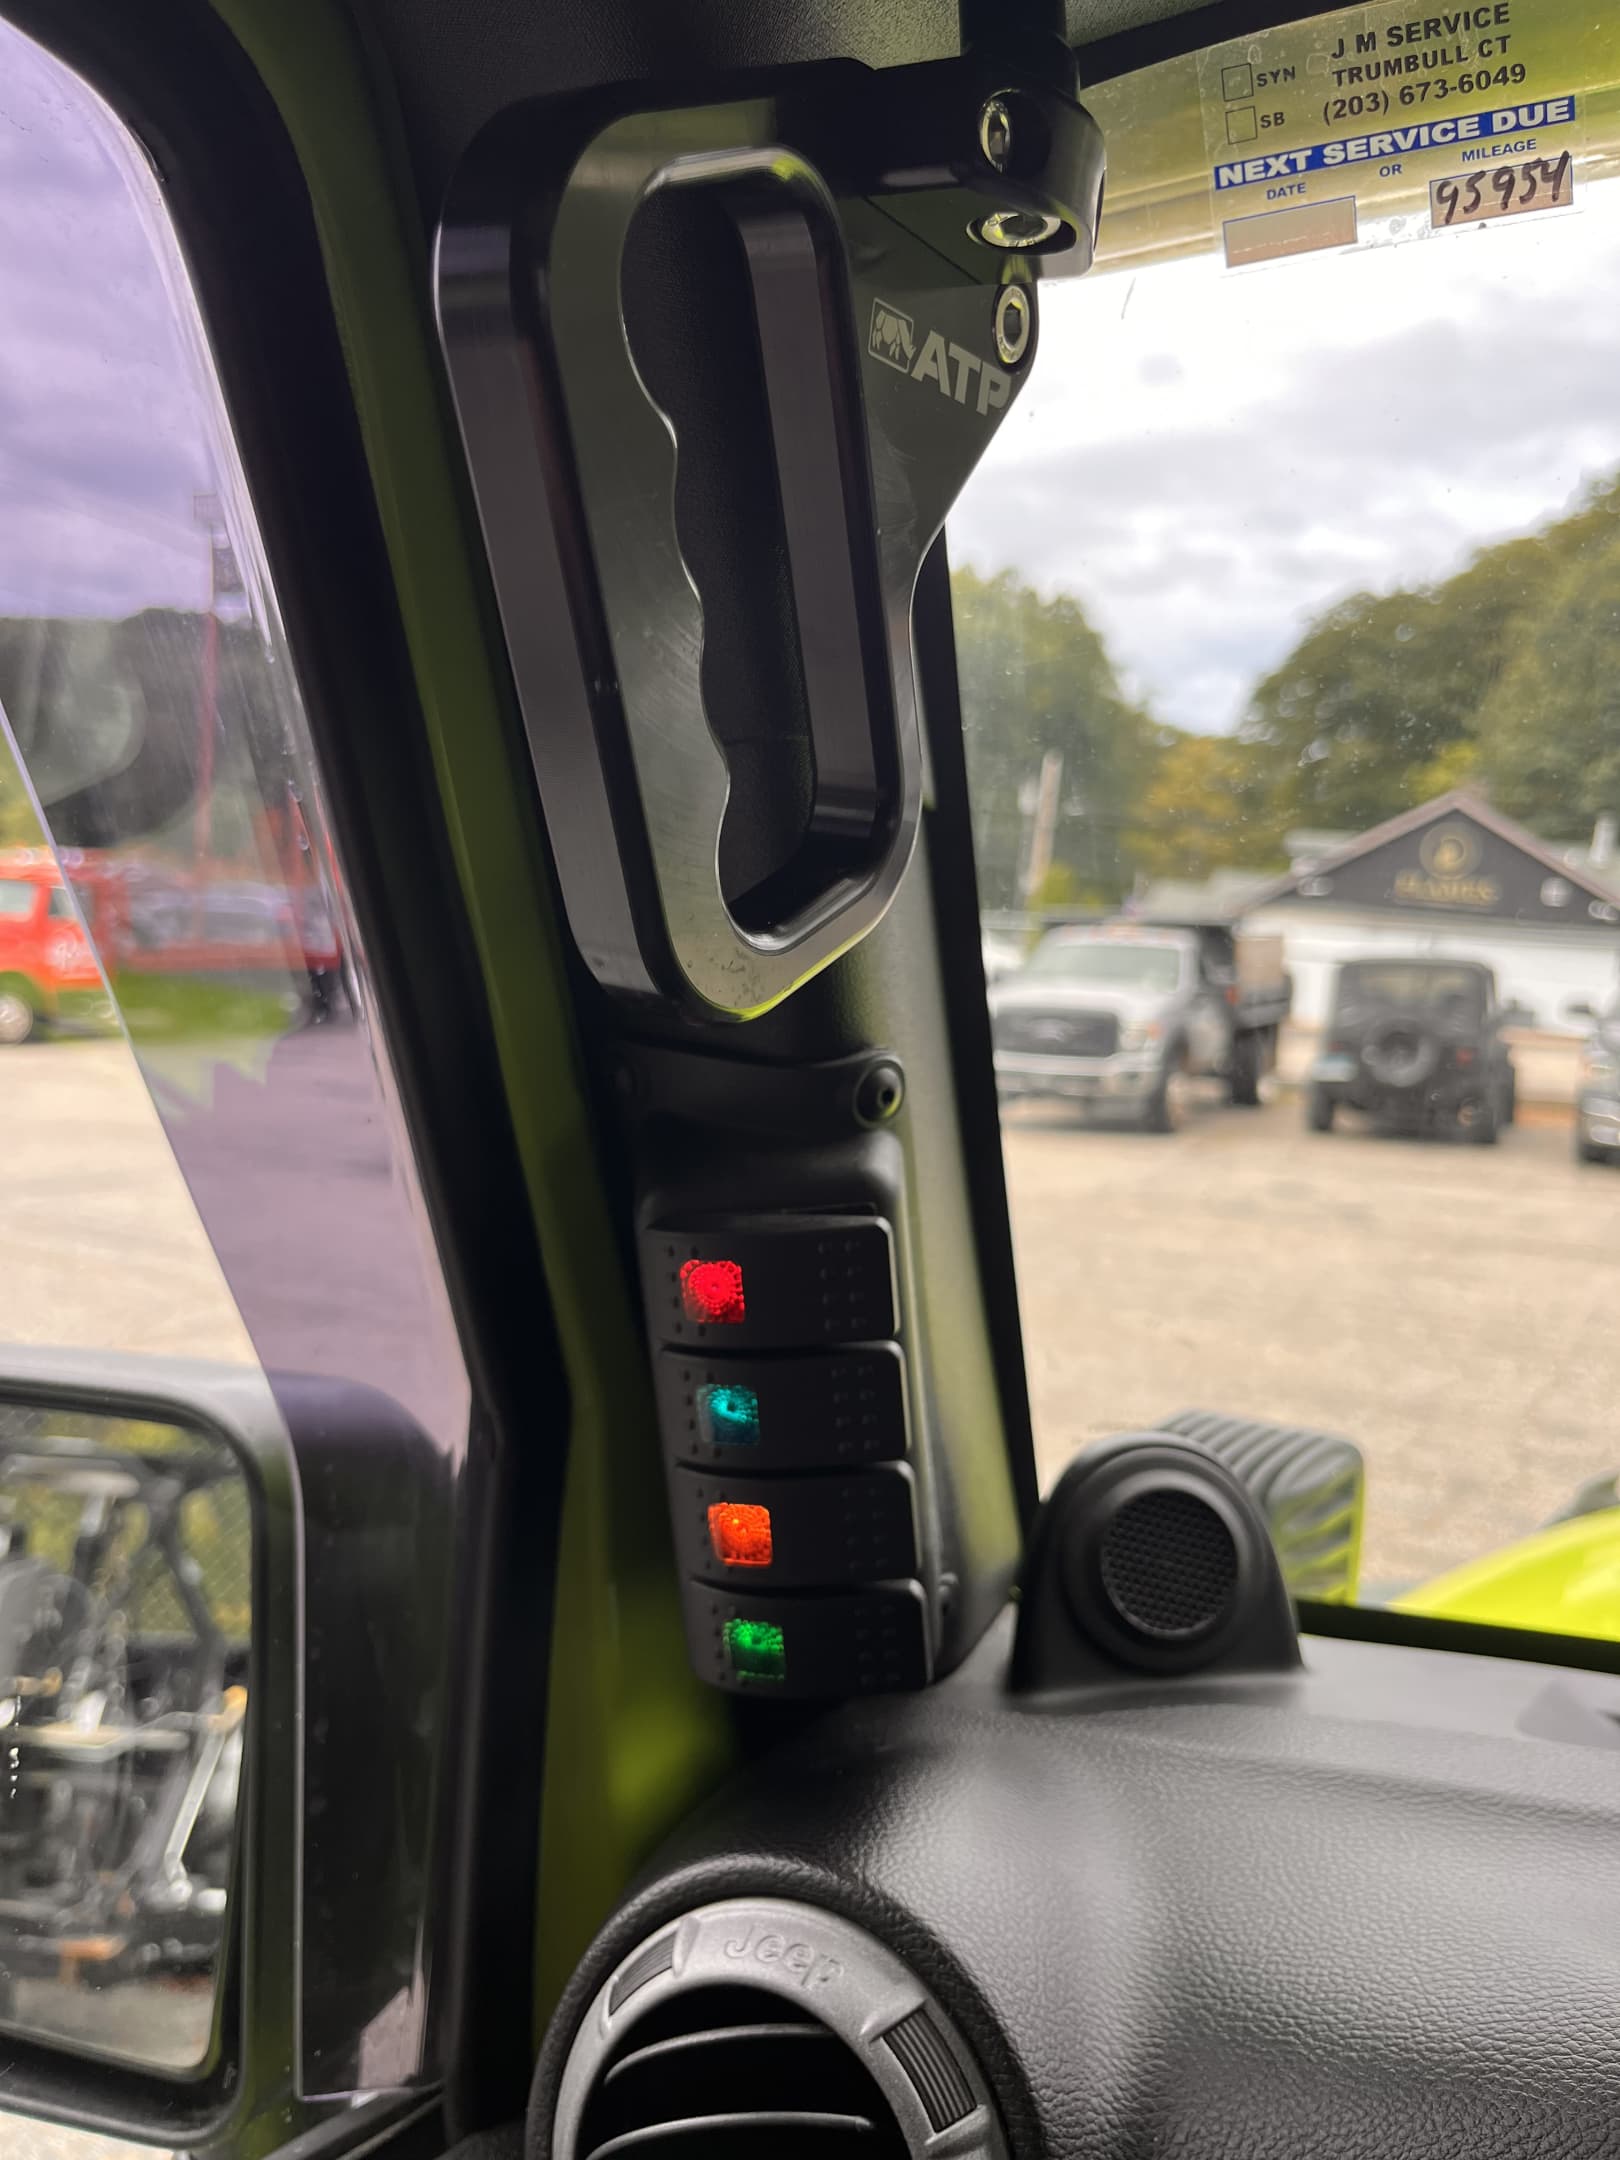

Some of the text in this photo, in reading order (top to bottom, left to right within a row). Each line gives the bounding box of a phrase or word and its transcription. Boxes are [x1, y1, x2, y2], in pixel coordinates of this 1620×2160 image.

[1331, 3, 1511, 59] J M SERVICE
[1256, 66, 1296, 88] SYN
[1332, 35, 1512, 88] TRUMBULL CT
[1259, 112, 1286, 129] SB
[1322, 63, 1526, 126] (203) 673-6049
[1218, 99, 1571, 188] NEXT SERVICE DUE
[1461, 138, 1537, 162] MILEAGE
[1266, 183, 1307, 200] DATE
[1379, 163, 1403, 178] OR
[910, 329, 1012, 417] ATP
[726, 1924, 843, 1989] Jeep
